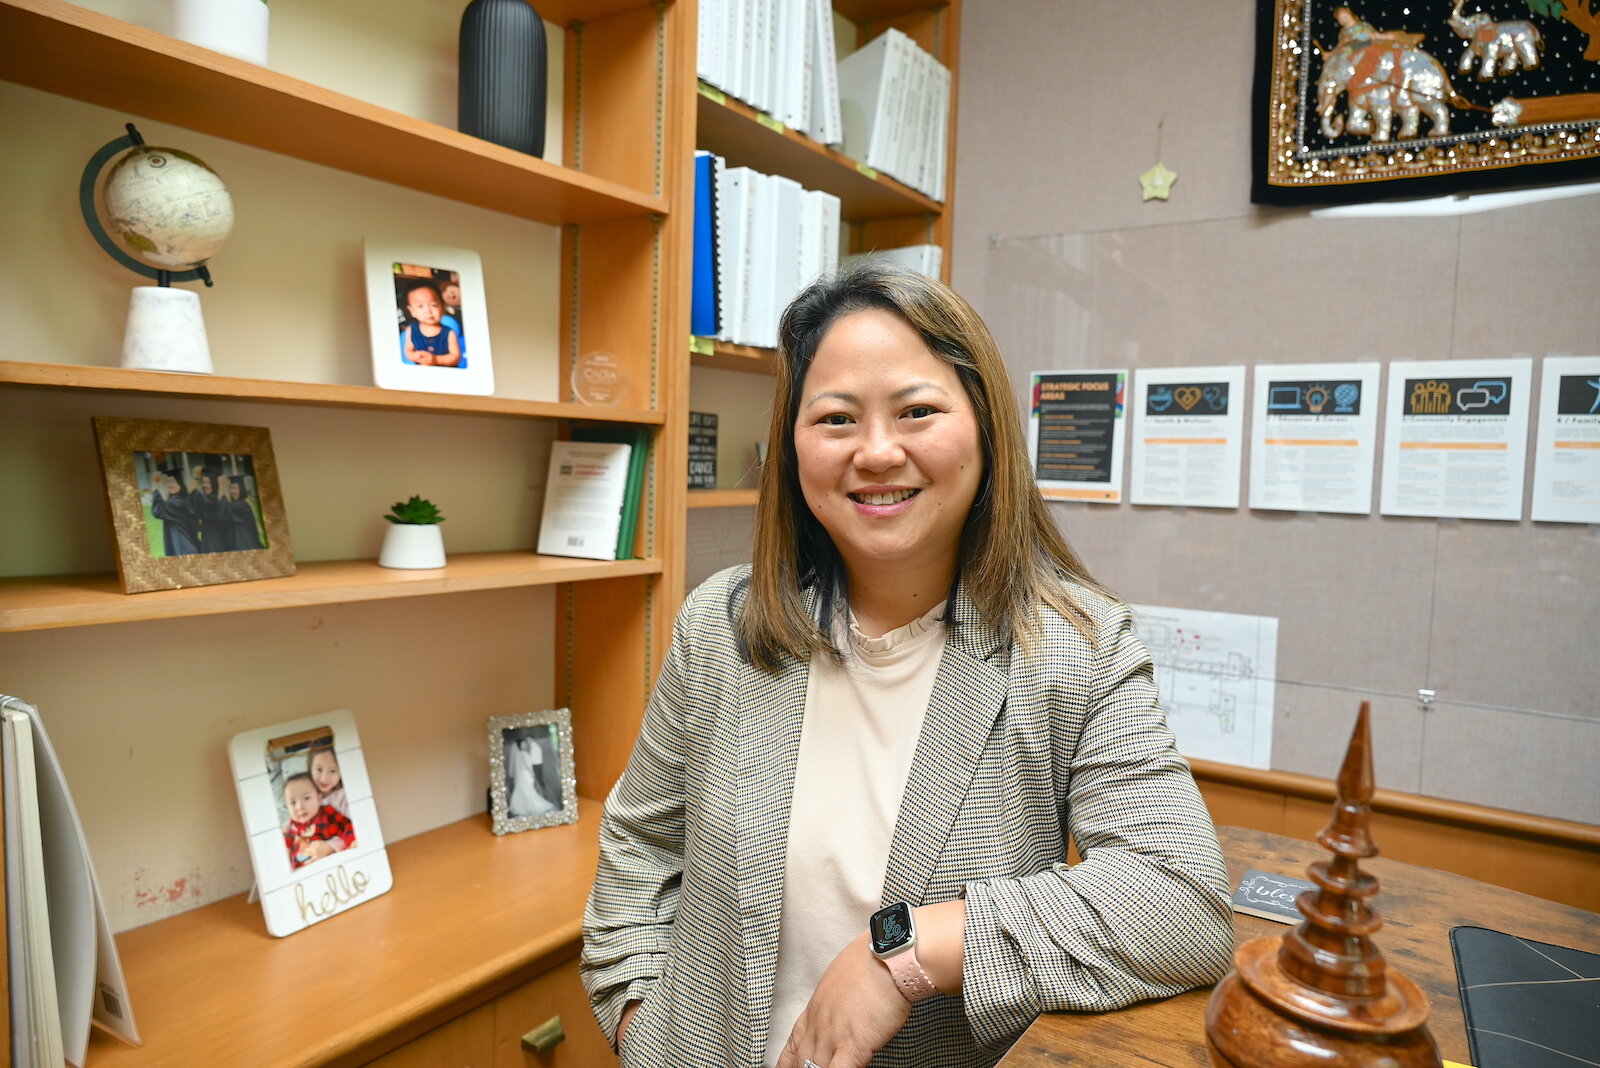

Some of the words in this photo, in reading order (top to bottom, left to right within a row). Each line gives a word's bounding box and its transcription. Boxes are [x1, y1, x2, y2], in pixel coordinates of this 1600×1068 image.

[1040, 382, 1081, 391] STRATEGIC
[1081, 381, 1109, 391] FOCUS
[1457, 414, 1507, 423] Engagement
[294, 864, 371, 926] hello
